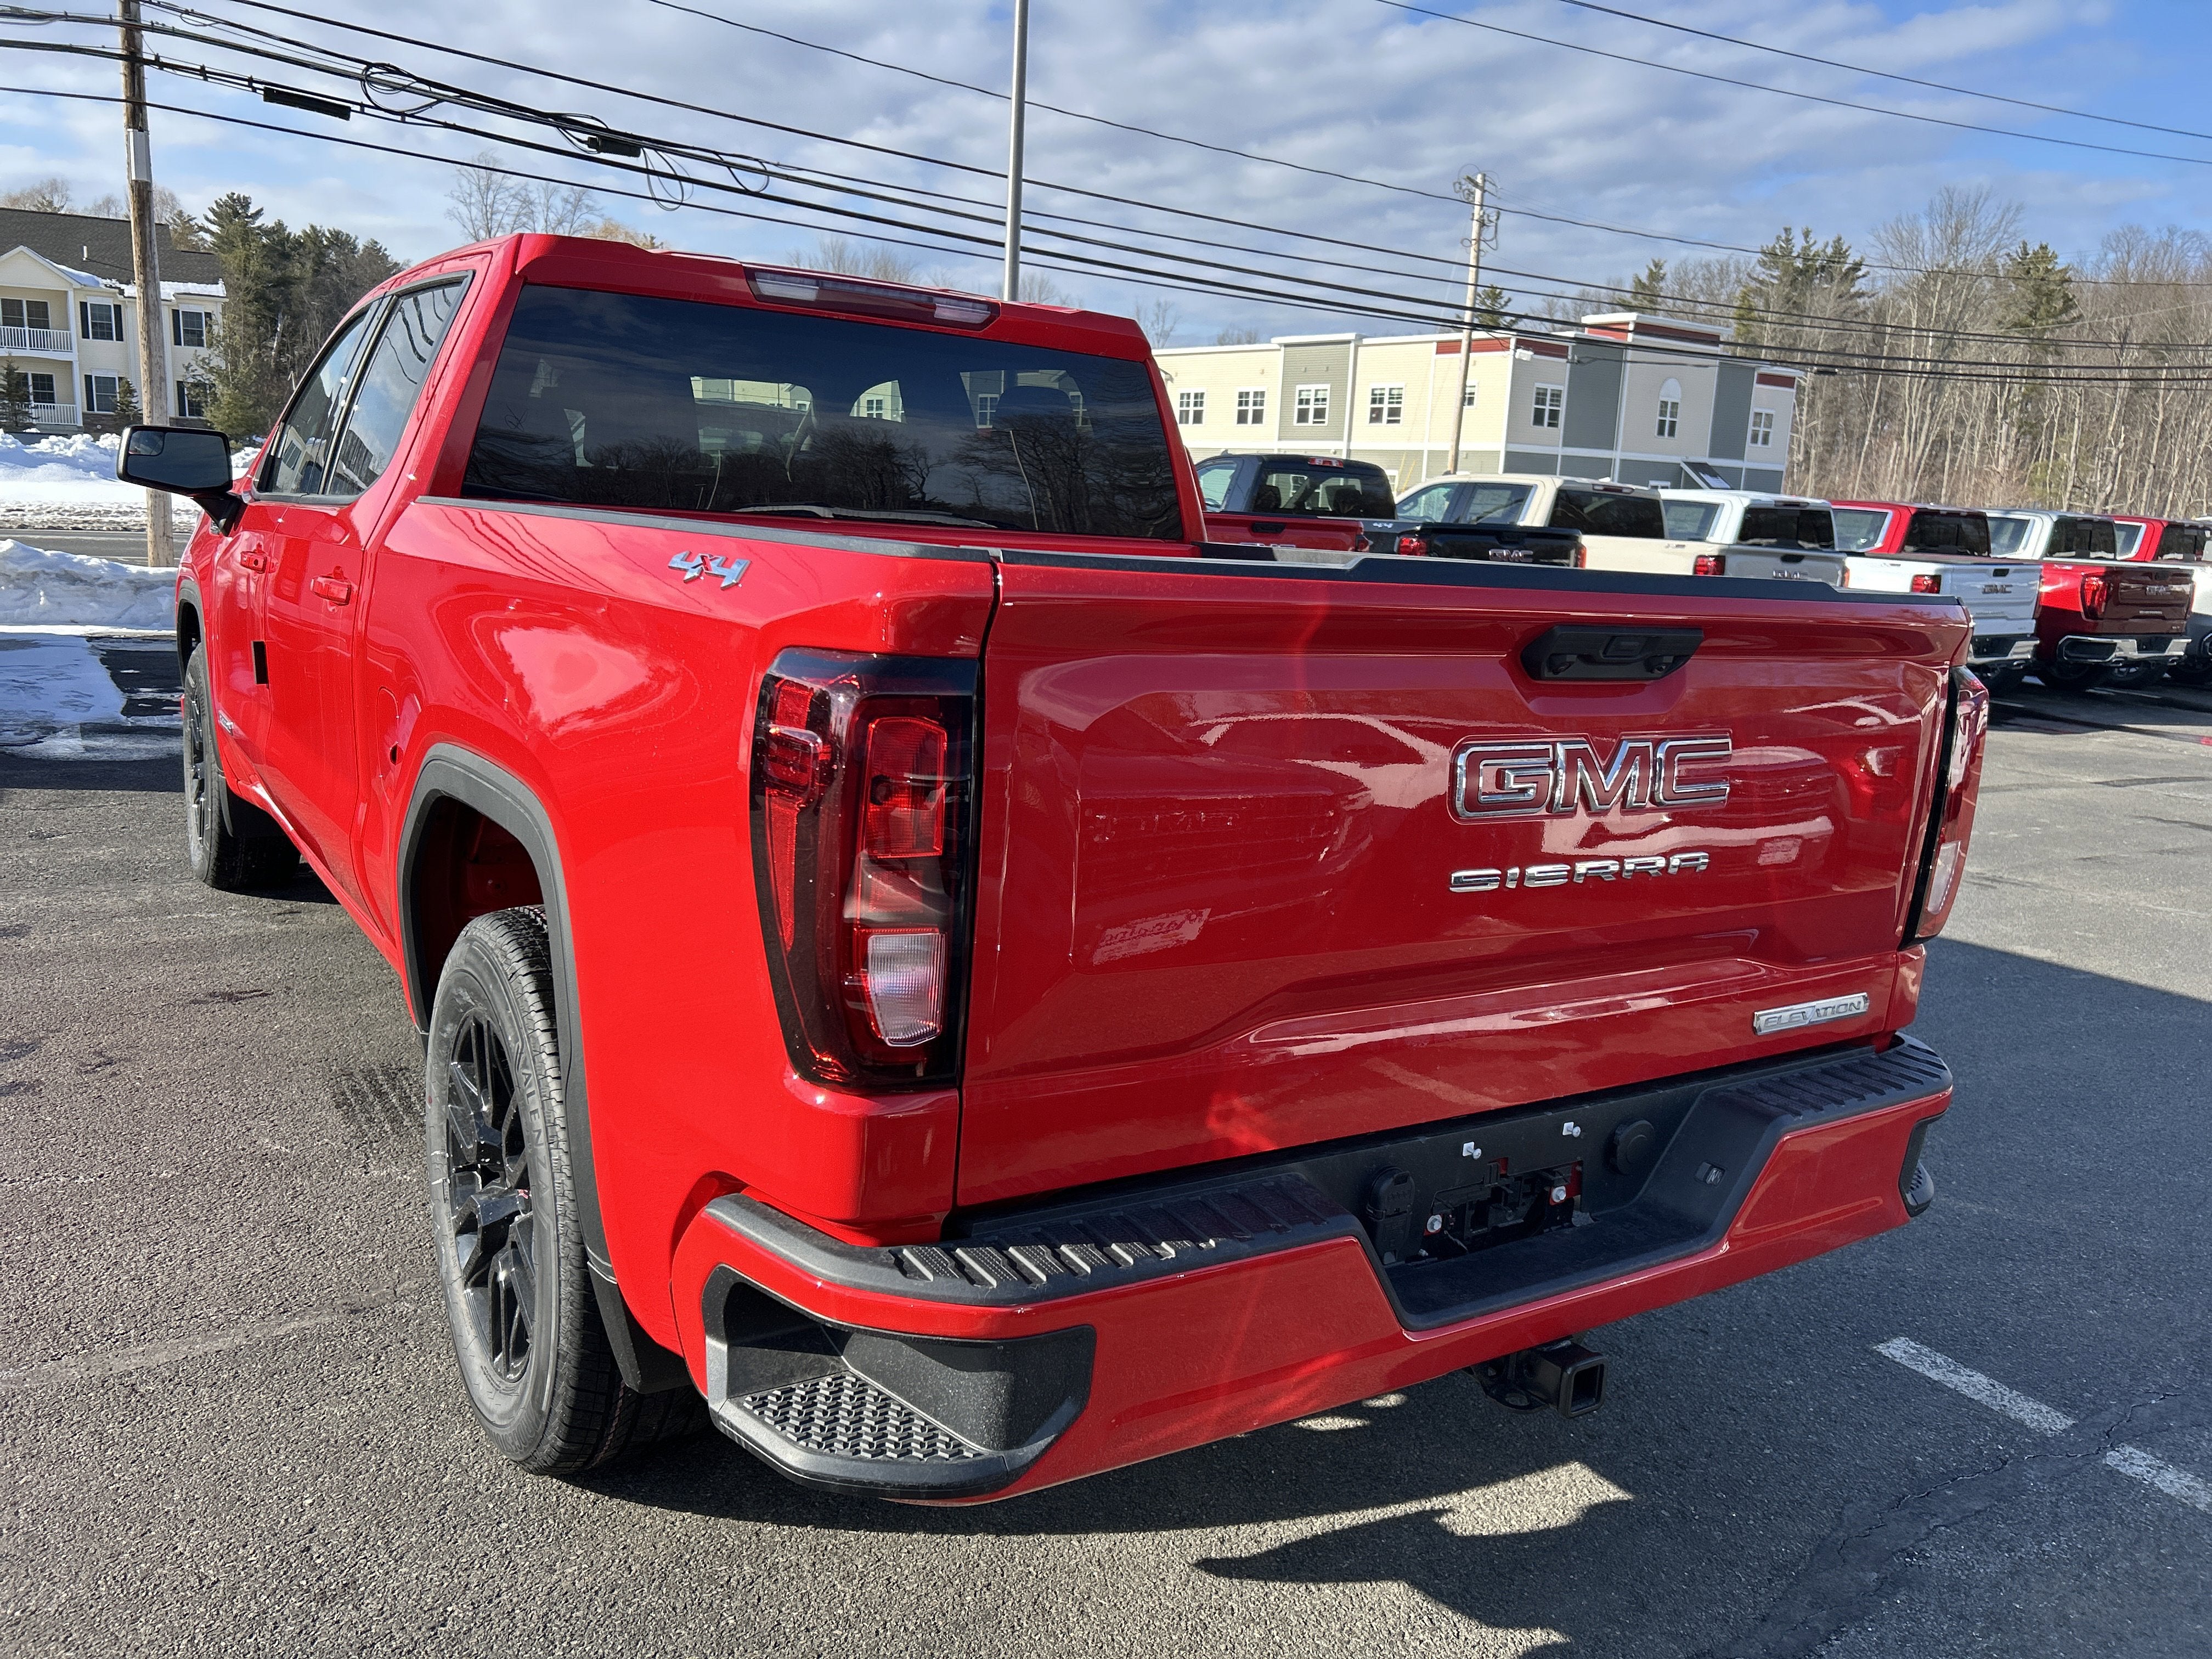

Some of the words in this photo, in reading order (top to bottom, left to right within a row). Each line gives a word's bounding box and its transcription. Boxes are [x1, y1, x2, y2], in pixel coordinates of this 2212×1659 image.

[1488, 549, 1533, 562] GMC
[1449, 732, 1733, 821] GMC
[1449, 851, 1709, 893] SIERRA
[1764, 1001, 1861, 1028] ELEVATION
[521, 1071, 549, 1195] ALENZA
